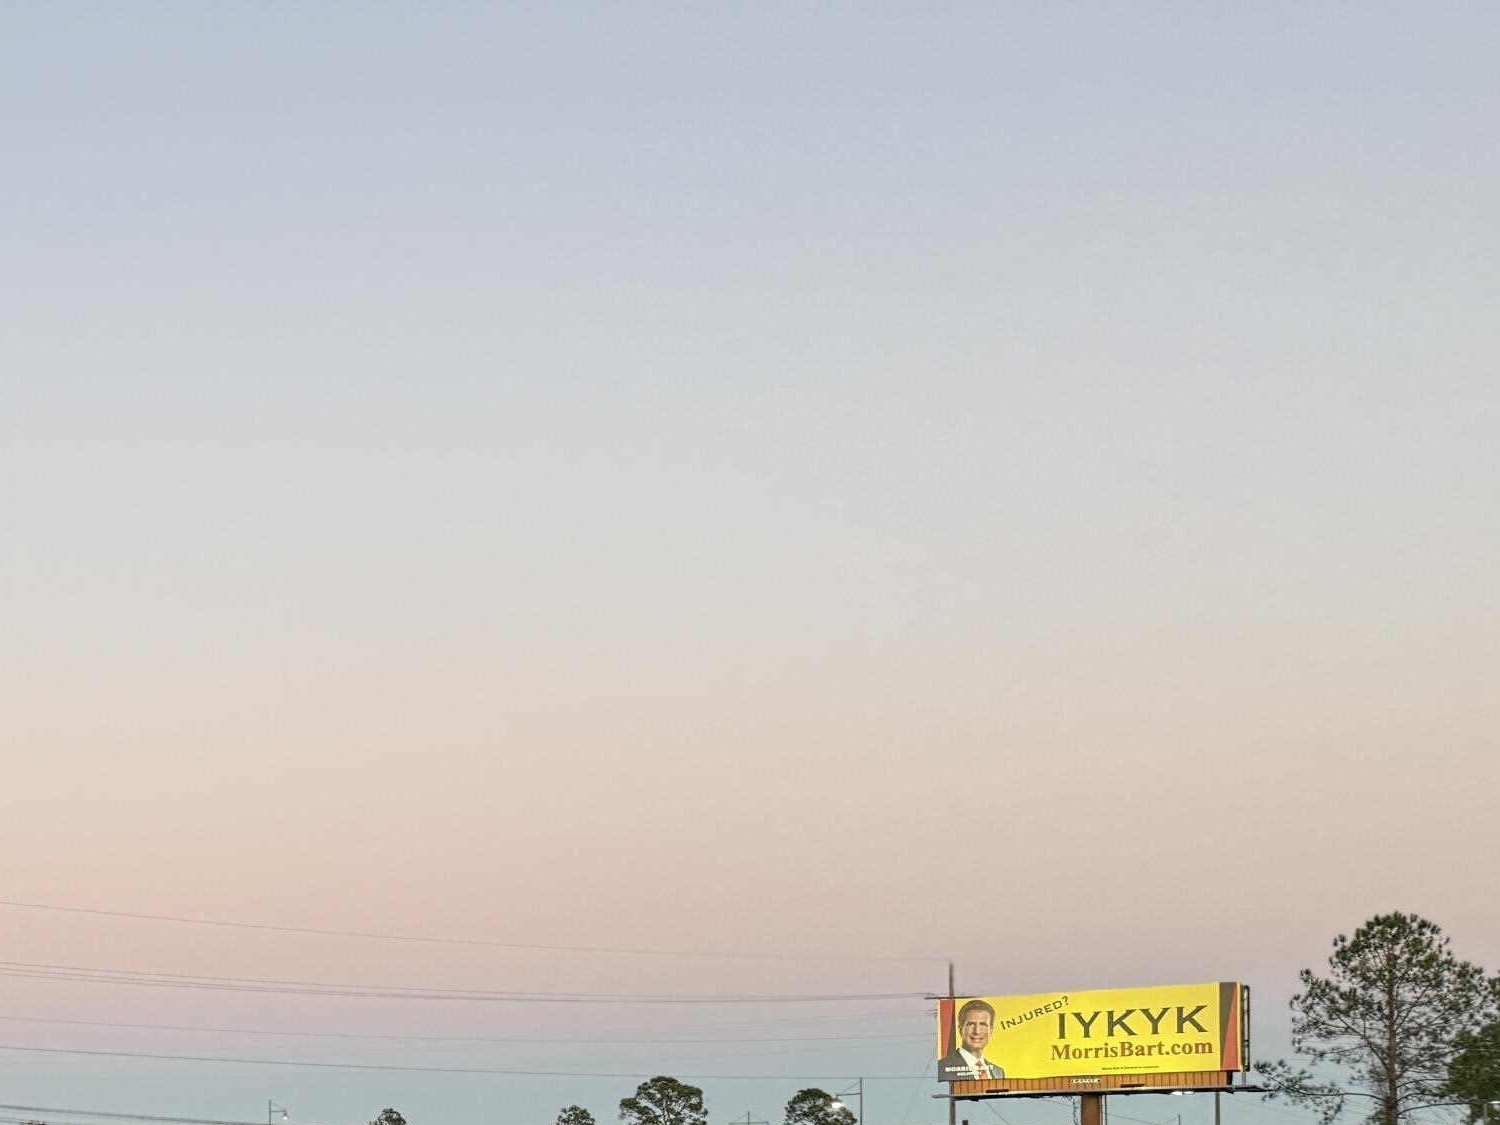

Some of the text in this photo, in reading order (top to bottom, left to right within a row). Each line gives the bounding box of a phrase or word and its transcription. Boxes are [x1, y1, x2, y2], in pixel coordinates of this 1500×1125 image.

[1000, 995, 1069, 1031] INJURED?
[1057, 1004, 1208, 1040] IYKYK
[1051, 1040, 1214, 1061] MorrisBart.com
